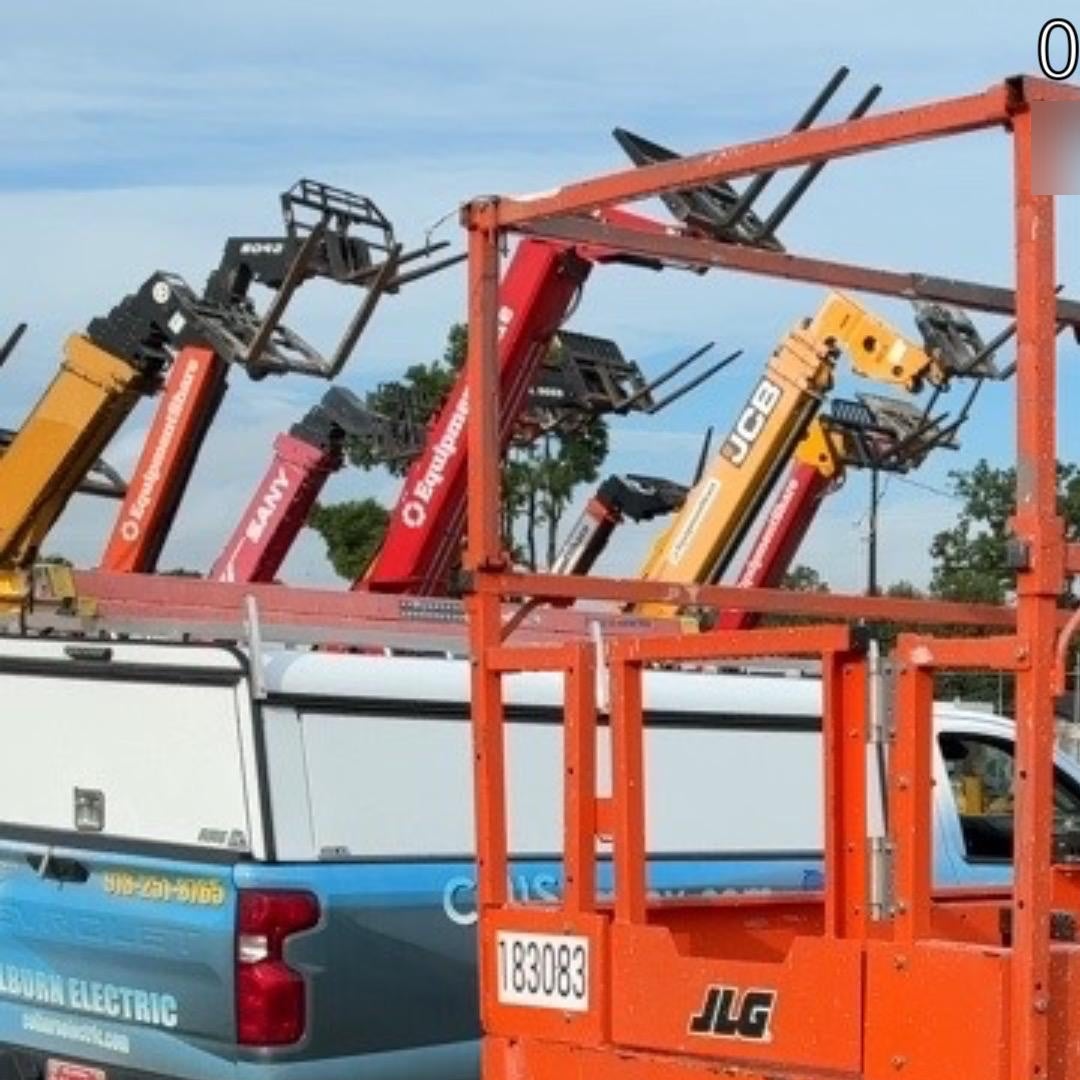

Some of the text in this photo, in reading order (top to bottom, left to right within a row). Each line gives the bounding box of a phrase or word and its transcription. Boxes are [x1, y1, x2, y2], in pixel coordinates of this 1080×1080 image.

[730, 380, 780, 464] JCB
[245, 465, 289, 544] SANY
[498, 941, 588, 999] 183083
[68, 977, 179, 1027] ELECTRIC
[690, 988, 775, 1039] JLG
